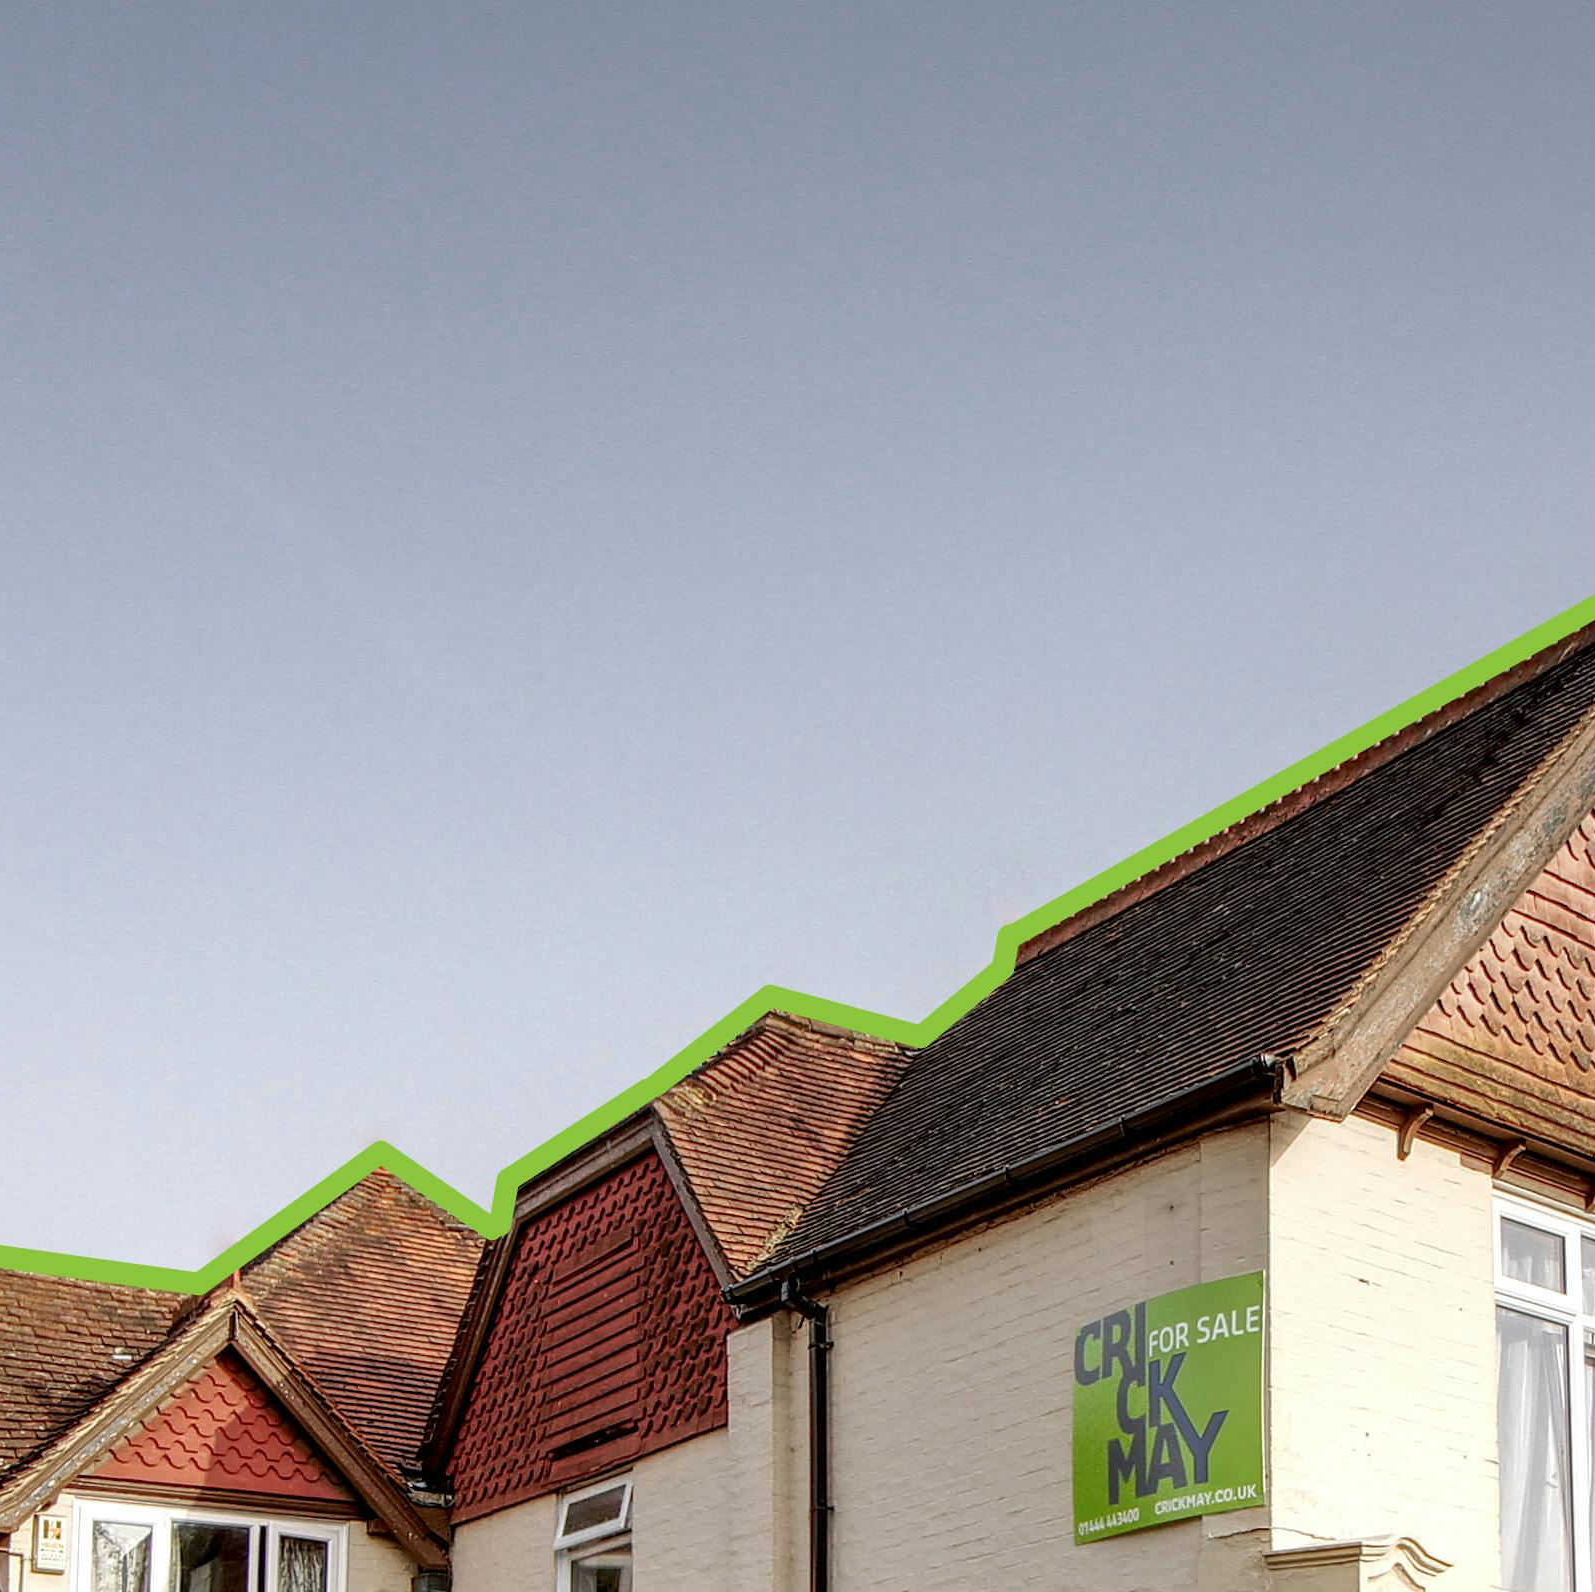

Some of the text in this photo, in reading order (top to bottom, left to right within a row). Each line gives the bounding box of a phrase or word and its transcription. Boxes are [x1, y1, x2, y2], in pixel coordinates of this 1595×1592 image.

[1149, 1305, 1260, 1357] FOR SALE
[1155, 1484, 1257, 1515] CRICKMAY.CO.UK
